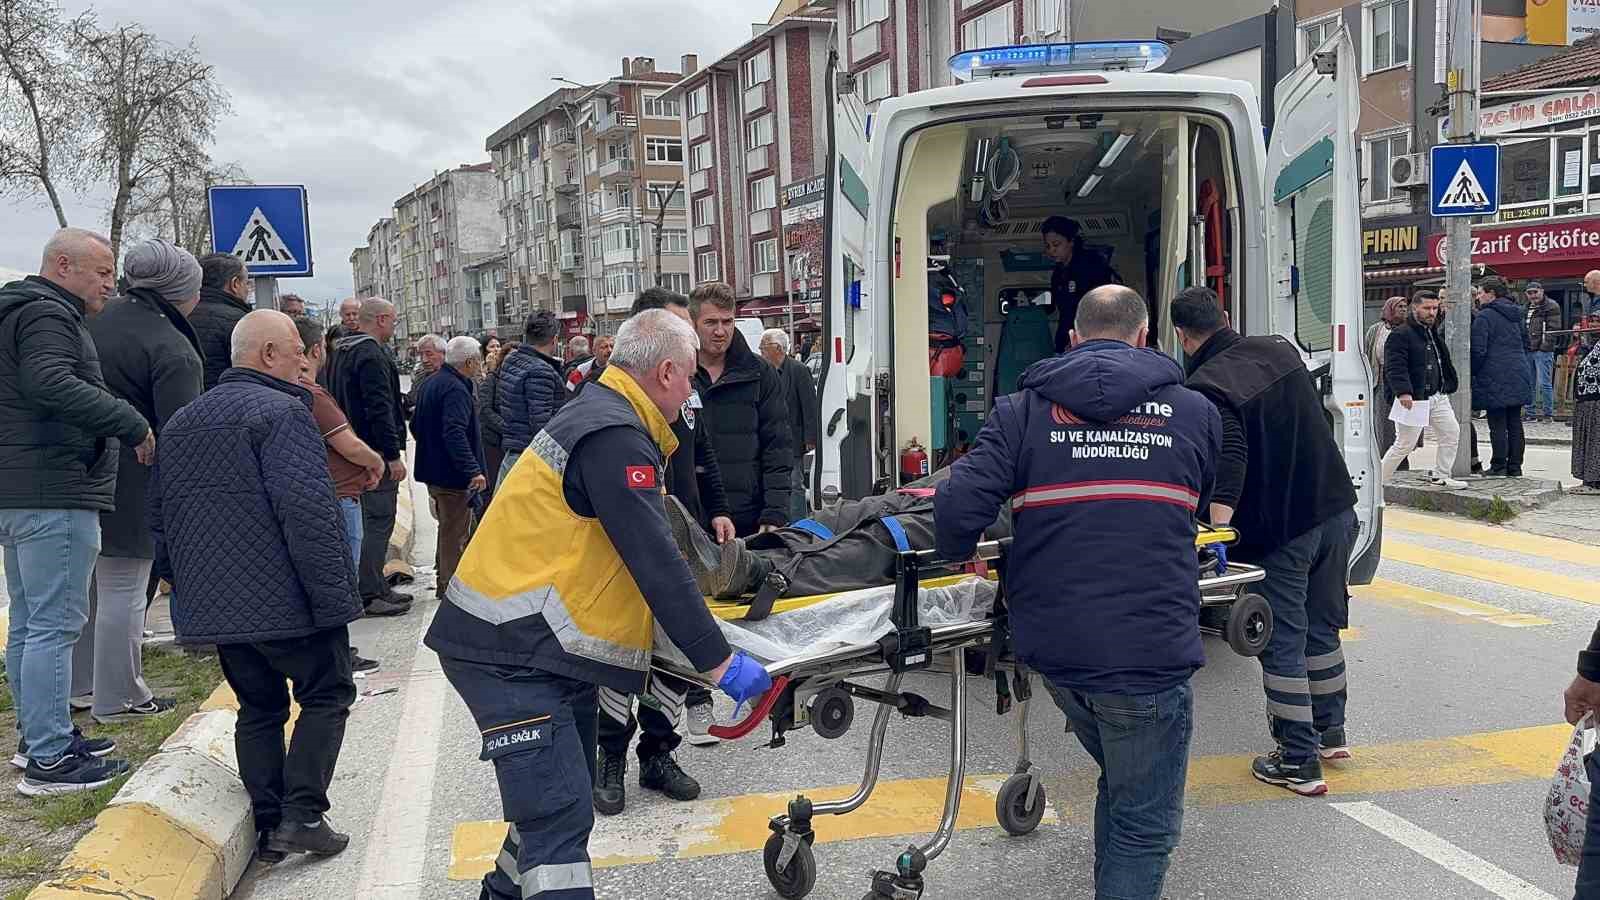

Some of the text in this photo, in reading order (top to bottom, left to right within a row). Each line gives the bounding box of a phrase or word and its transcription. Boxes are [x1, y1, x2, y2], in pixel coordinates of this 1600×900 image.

[1363, 225, 1418, 254] FIRINI
[1470, 228, 1600, 255] Zarif Çiğköfte
[1050, 428, 1172, 448] SU VE KANALİZASYON
[1072, 444, 1149, 460] MÜDÜRLÜĞÜ
[511, 729, 541, 744] SAĞLIK
